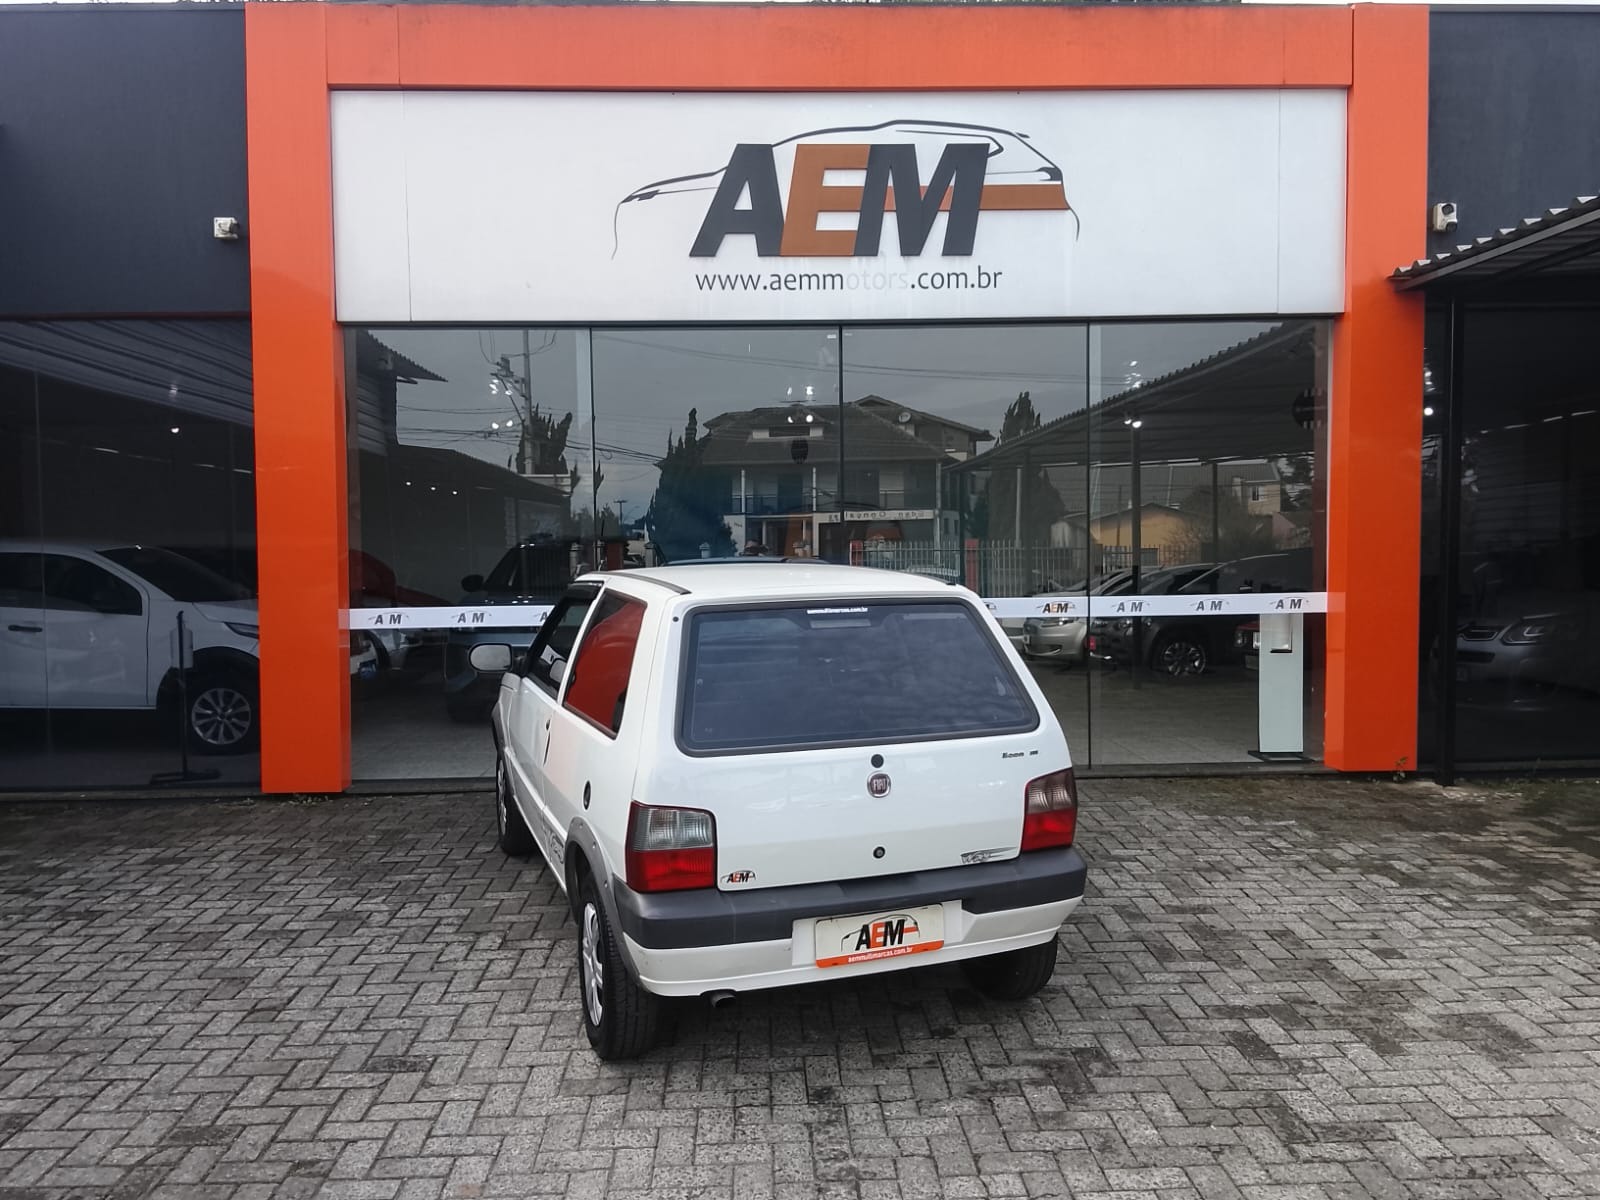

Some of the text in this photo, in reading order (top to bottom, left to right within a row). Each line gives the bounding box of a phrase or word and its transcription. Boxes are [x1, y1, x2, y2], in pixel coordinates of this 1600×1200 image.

[689, 143, 990, 257] AEM
[695, 265, 1003, 291] www.aemmotors.com.br
[1042, 602, 1069, 613] AEM
[726, 871, 750, 884] AEM
[855, 918, 906, 951] AEM
